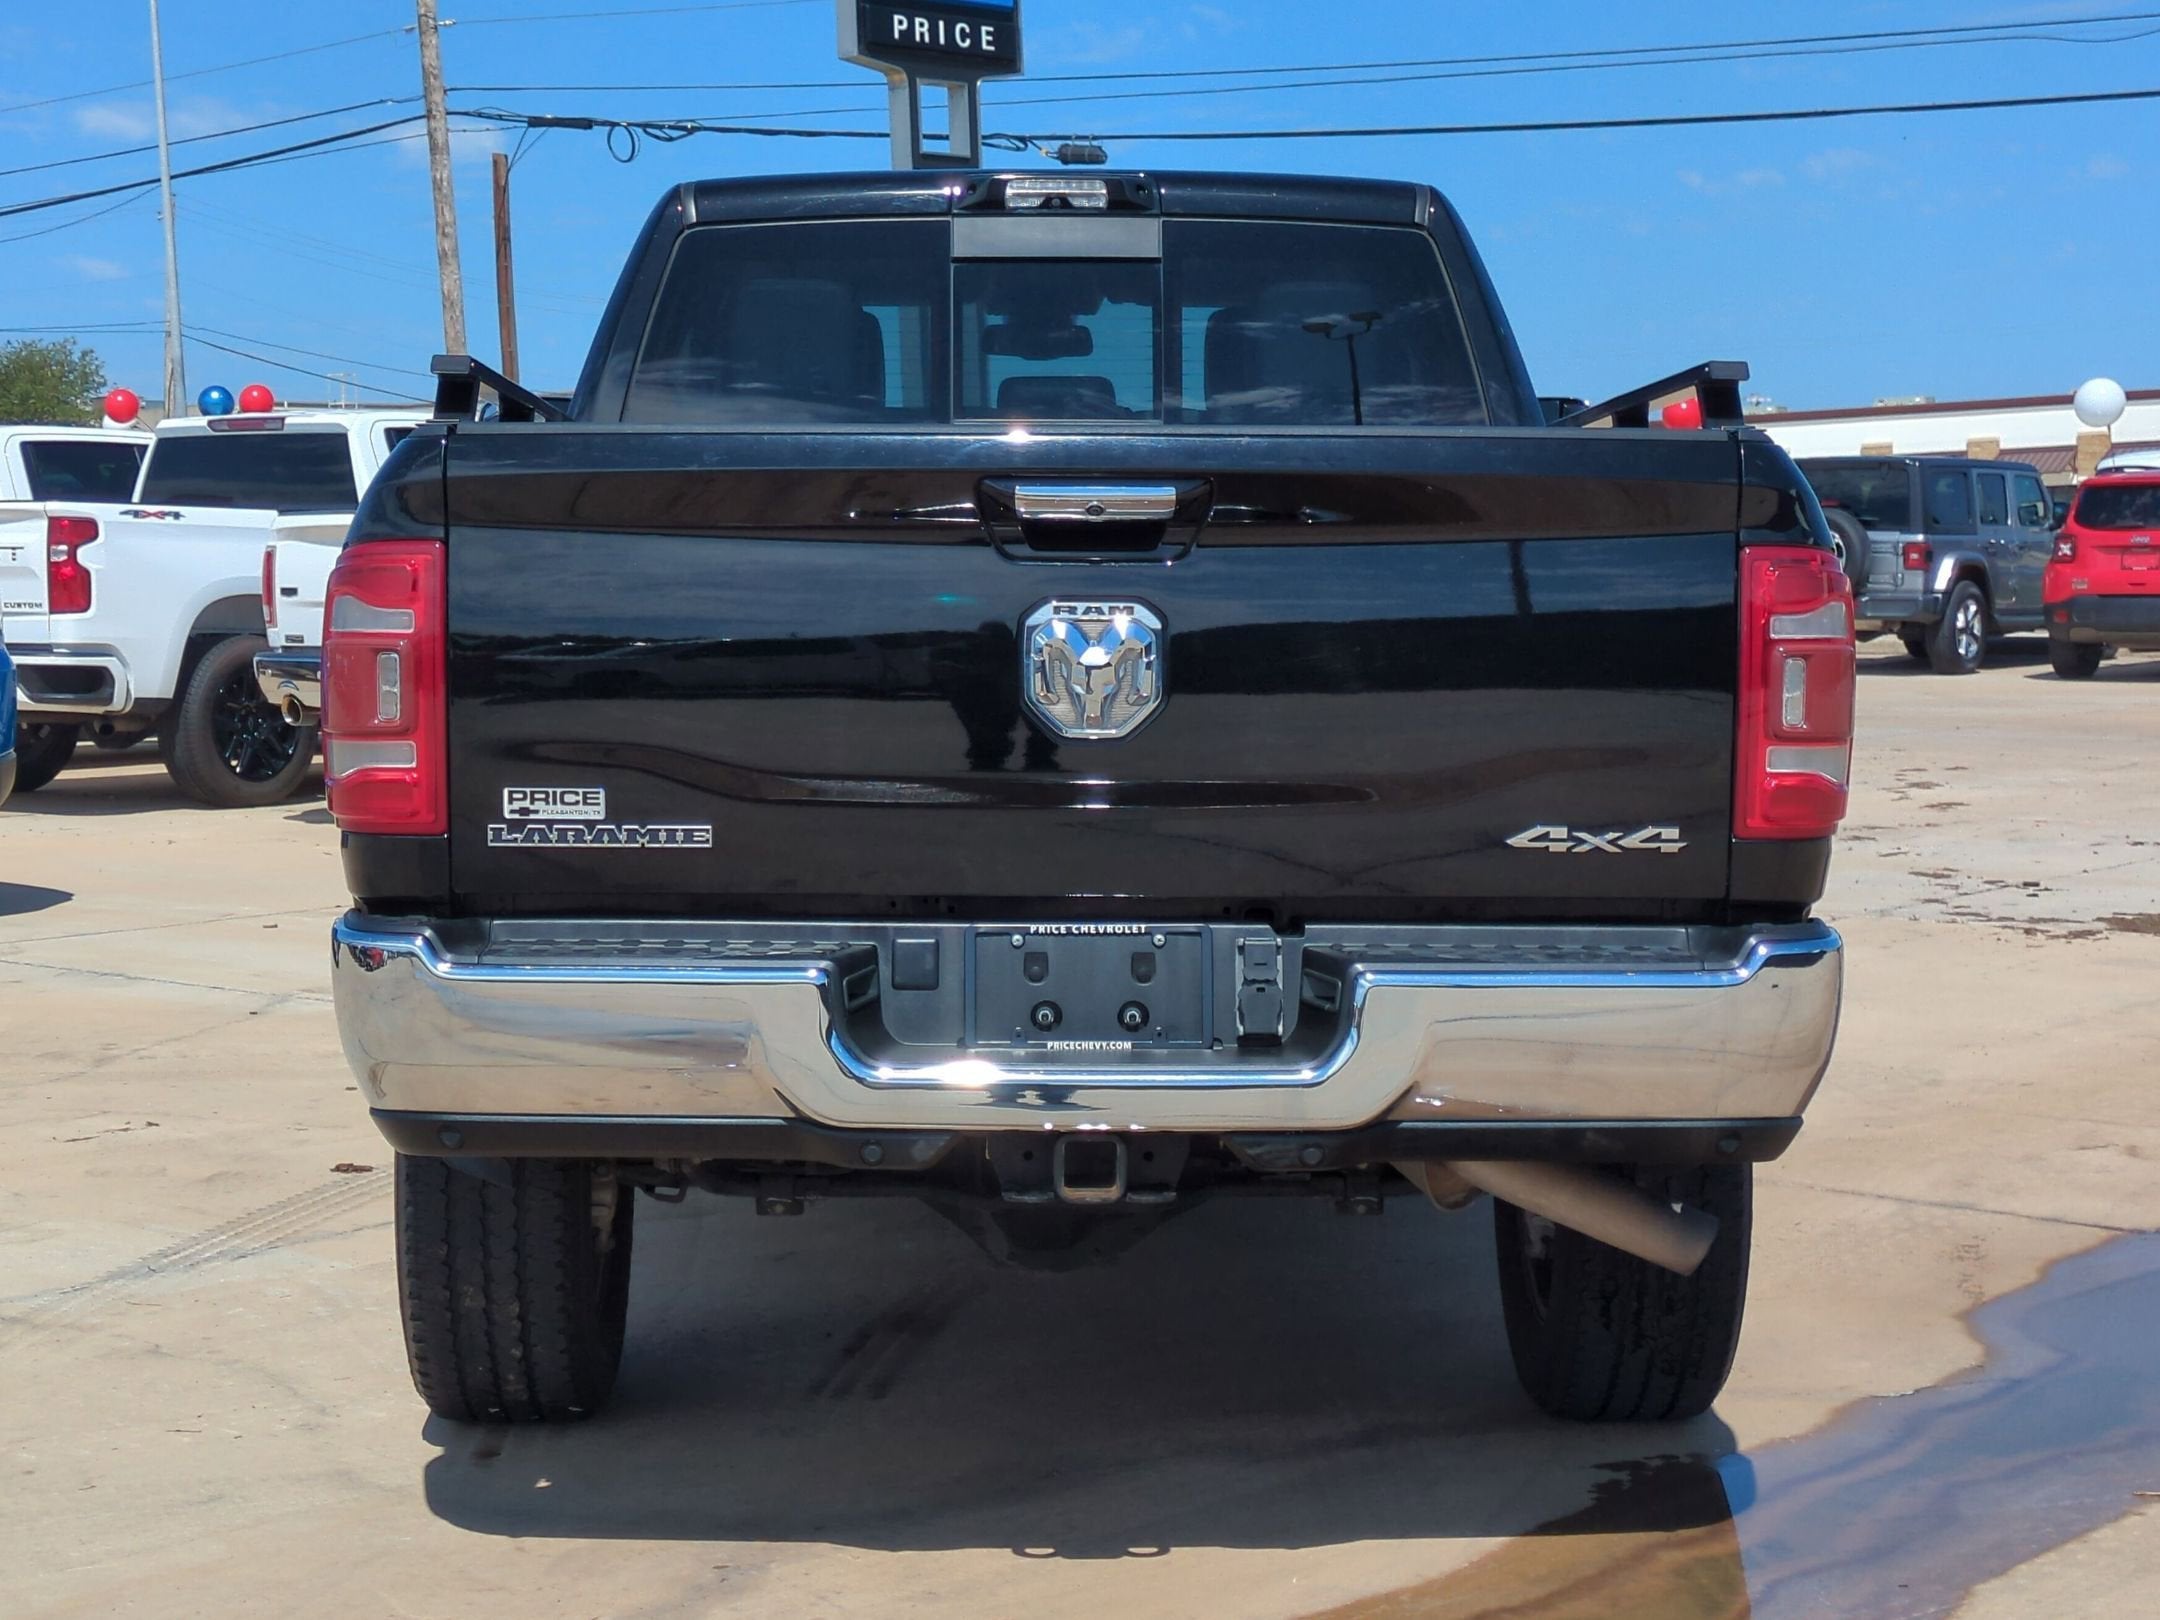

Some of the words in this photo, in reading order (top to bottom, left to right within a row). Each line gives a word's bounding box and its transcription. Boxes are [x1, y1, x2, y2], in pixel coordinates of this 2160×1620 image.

[892, 14, 996, 51] PRICE
[1052, 605, 1135, 616] RAM
[507, 789, 601, 806] PRICE
[487, 824, 713, 848] LARAMIE
[1029, 924, 1068, 934] PRICE
[1071, 924, 1147, 934] CHEVROLET
[1046, 1040, 1133, 1050] PRICECHEVY.COM
